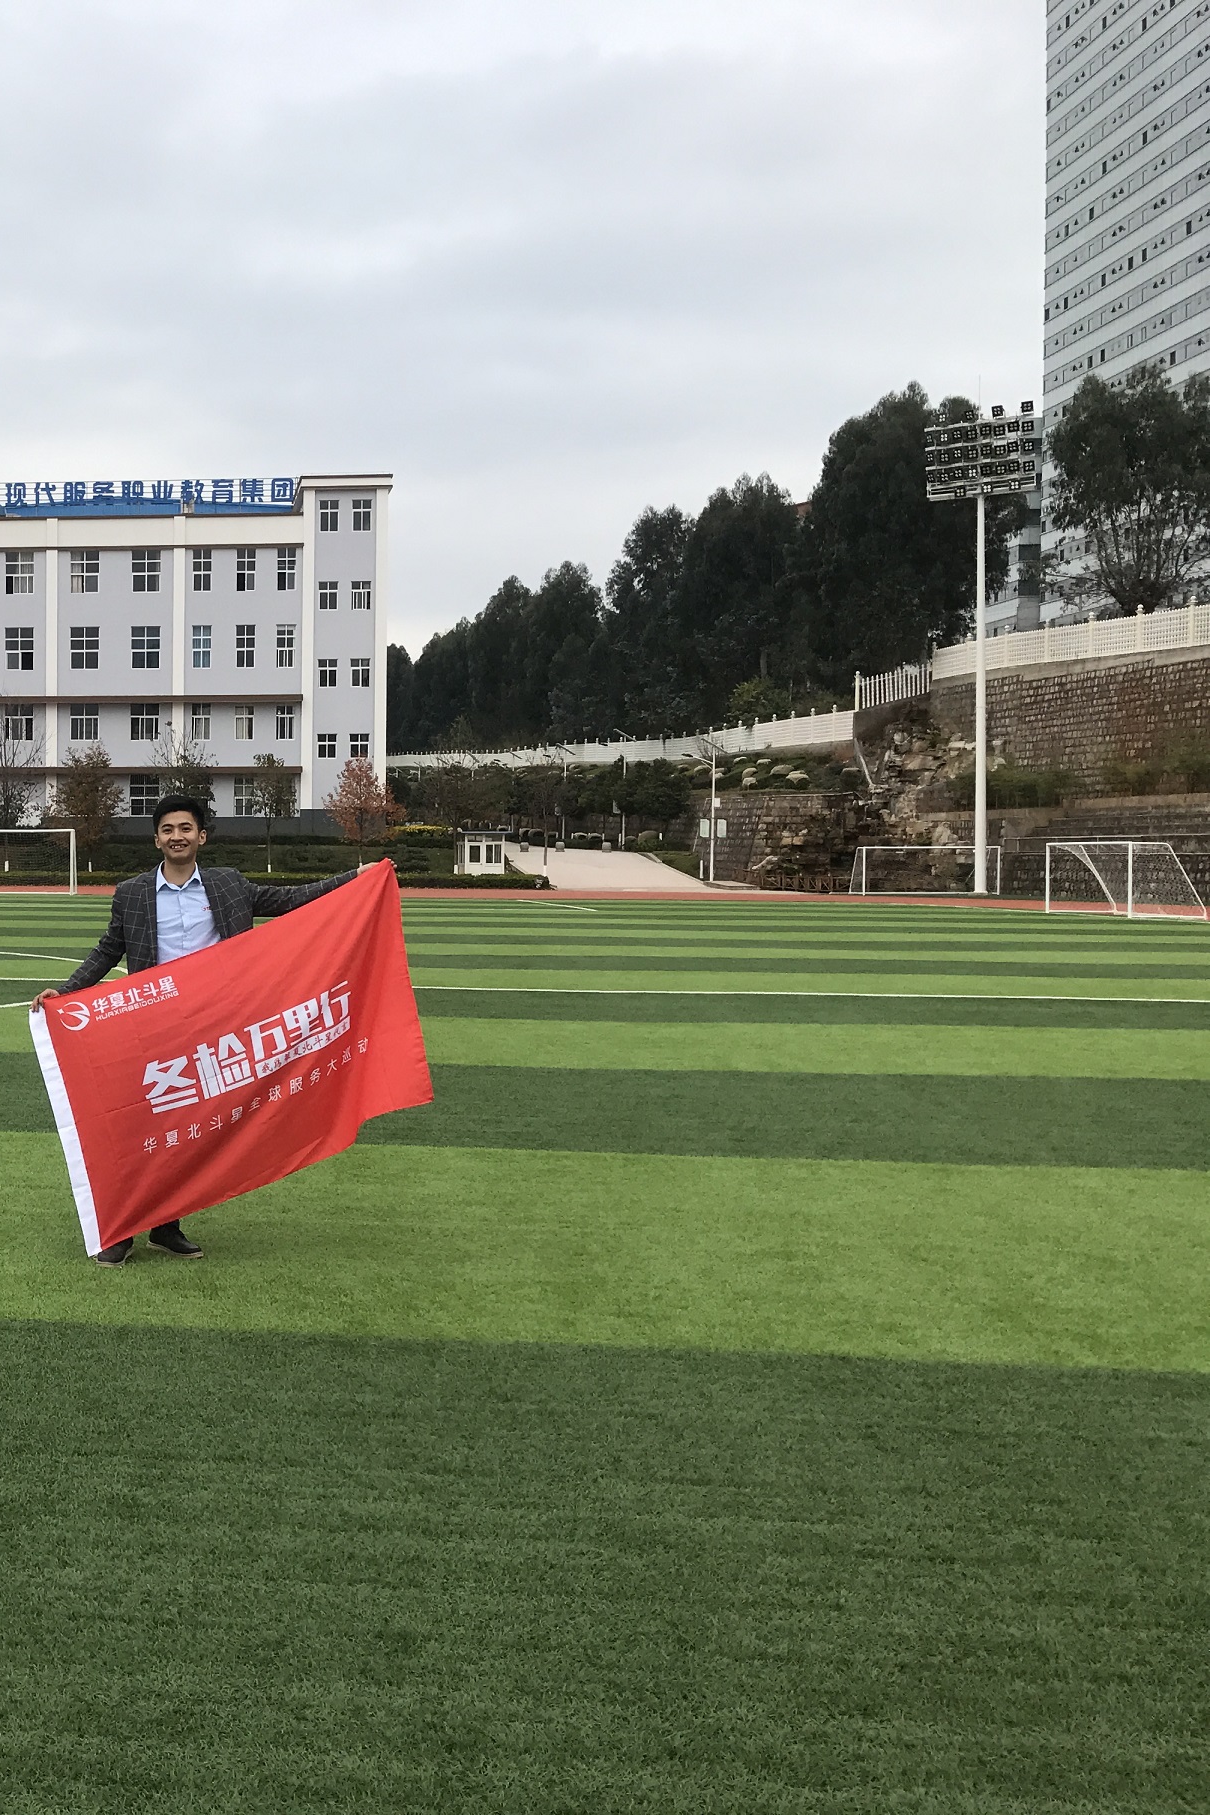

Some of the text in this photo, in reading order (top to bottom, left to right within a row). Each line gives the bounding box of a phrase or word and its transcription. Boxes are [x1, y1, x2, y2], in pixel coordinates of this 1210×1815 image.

[92, 976, 178, 1013] 华夏北斗星
[95, 990, 179, 1021] HUAXIABEIDOUXING
[142, 981, 352, 1114] 冬检万里行
[143, 1037, 369, 1154] 华夏北斗星全球服务大巡动
